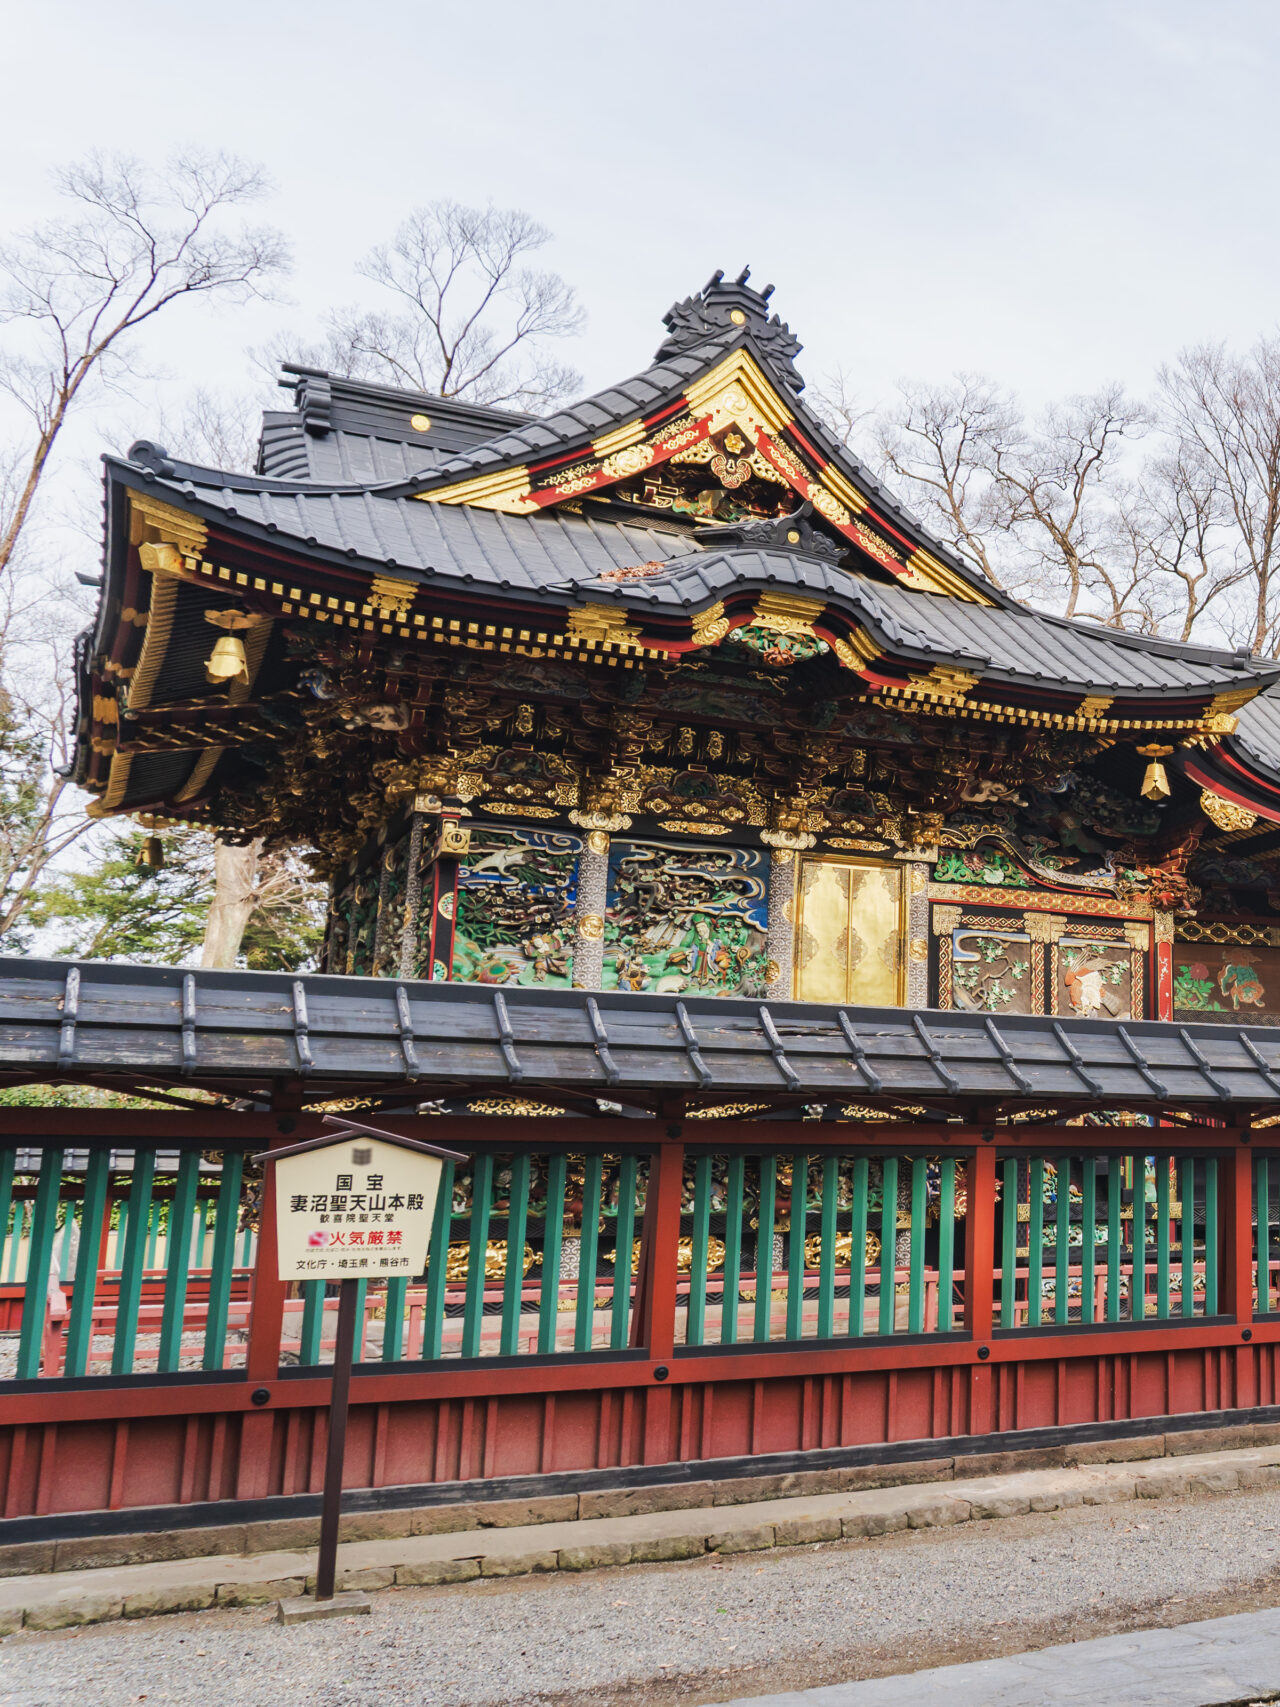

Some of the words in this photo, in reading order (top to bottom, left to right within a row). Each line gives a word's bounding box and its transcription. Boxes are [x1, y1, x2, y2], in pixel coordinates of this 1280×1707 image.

[290, 1193, 424, 1213] 妻沼聖天山本殿
[329, 1230, 403, 1246] 火気厳禁
